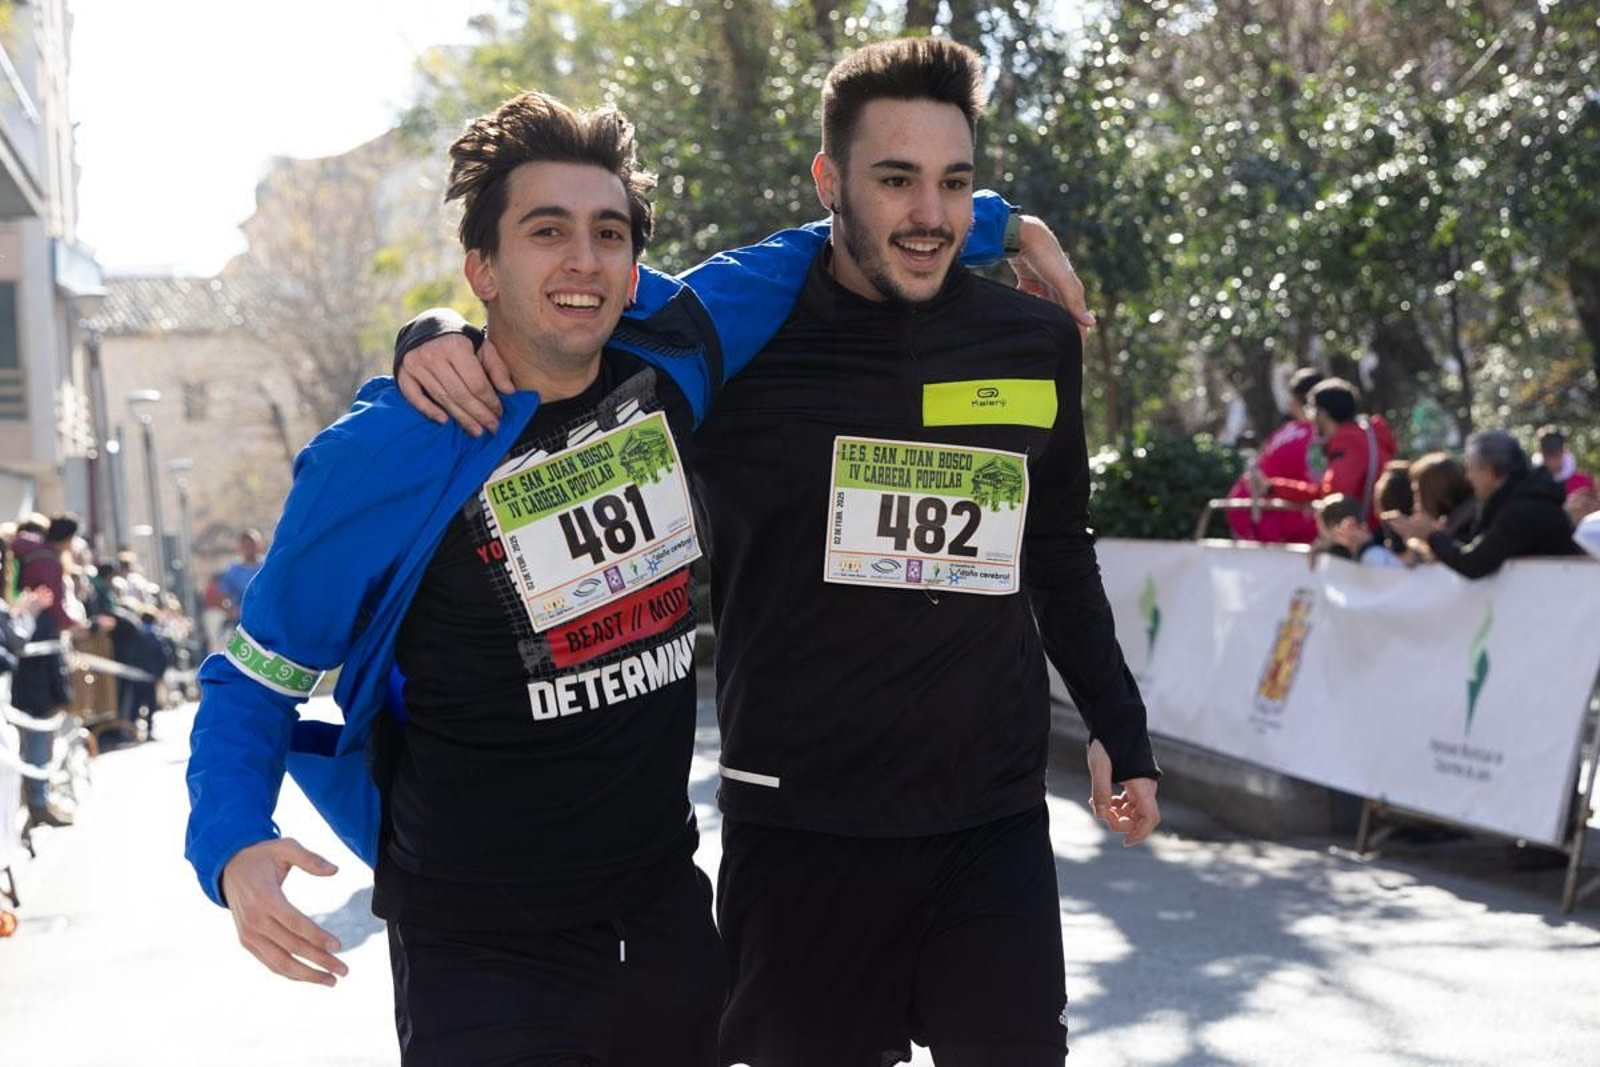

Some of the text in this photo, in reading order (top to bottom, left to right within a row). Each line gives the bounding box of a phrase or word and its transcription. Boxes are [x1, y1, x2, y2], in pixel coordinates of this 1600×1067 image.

[491, 441, 615, 505] I.E.S. SAN JUAN BOSCO
[849, 463, 963, 489] IV CARRERA POPULAR
[873, 445, 897, 465] SAN
[901, 448, 934, 468] JUAN
[938, 452, 973, 471] BOSCO
[506, 463, 616, 519] IV CARRERA POPULAR
[558, 484, 656, 565] 481
[876, 493, 982, 557] 482
[980, 571, 1010, 580] cerebral
[565, 611, 623, 653] BEAST
